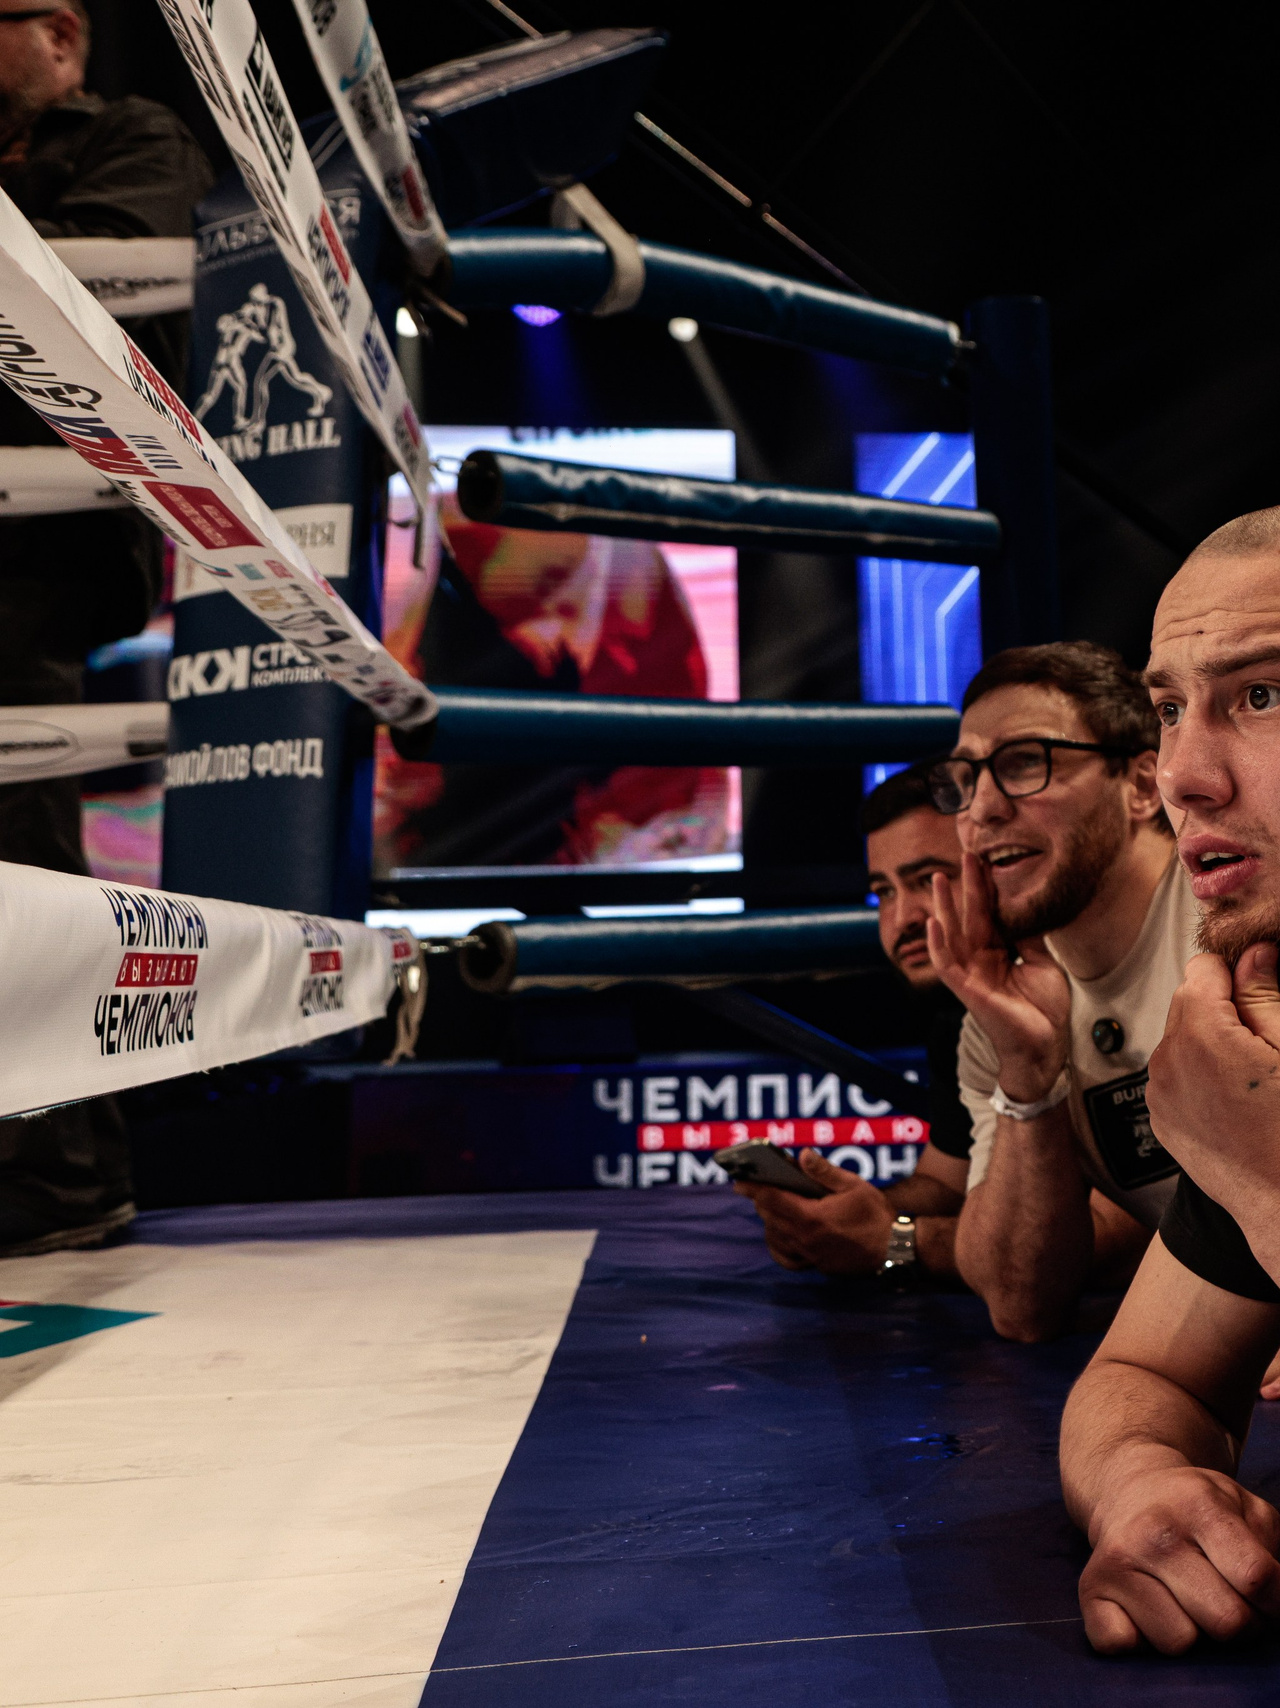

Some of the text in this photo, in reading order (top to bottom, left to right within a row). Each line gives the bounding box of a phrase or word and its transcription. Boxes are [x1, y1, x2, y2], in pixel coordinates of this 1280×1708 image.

[266, 417, 342, 457] HALL
[252, 737, 324, 779] ФОНД
[100, 886, 209, 949] ЧЕМПИОНЫ
[119, 958, 196, 982] ВЫЗЫВАЮТ
[94, 990, 198, 1056] ЧЕМПИОНОВ
[593, 1072, 919, 1124] ЧЕМПИО
[593, 1145, 918, 1188] ЧЕМОН
